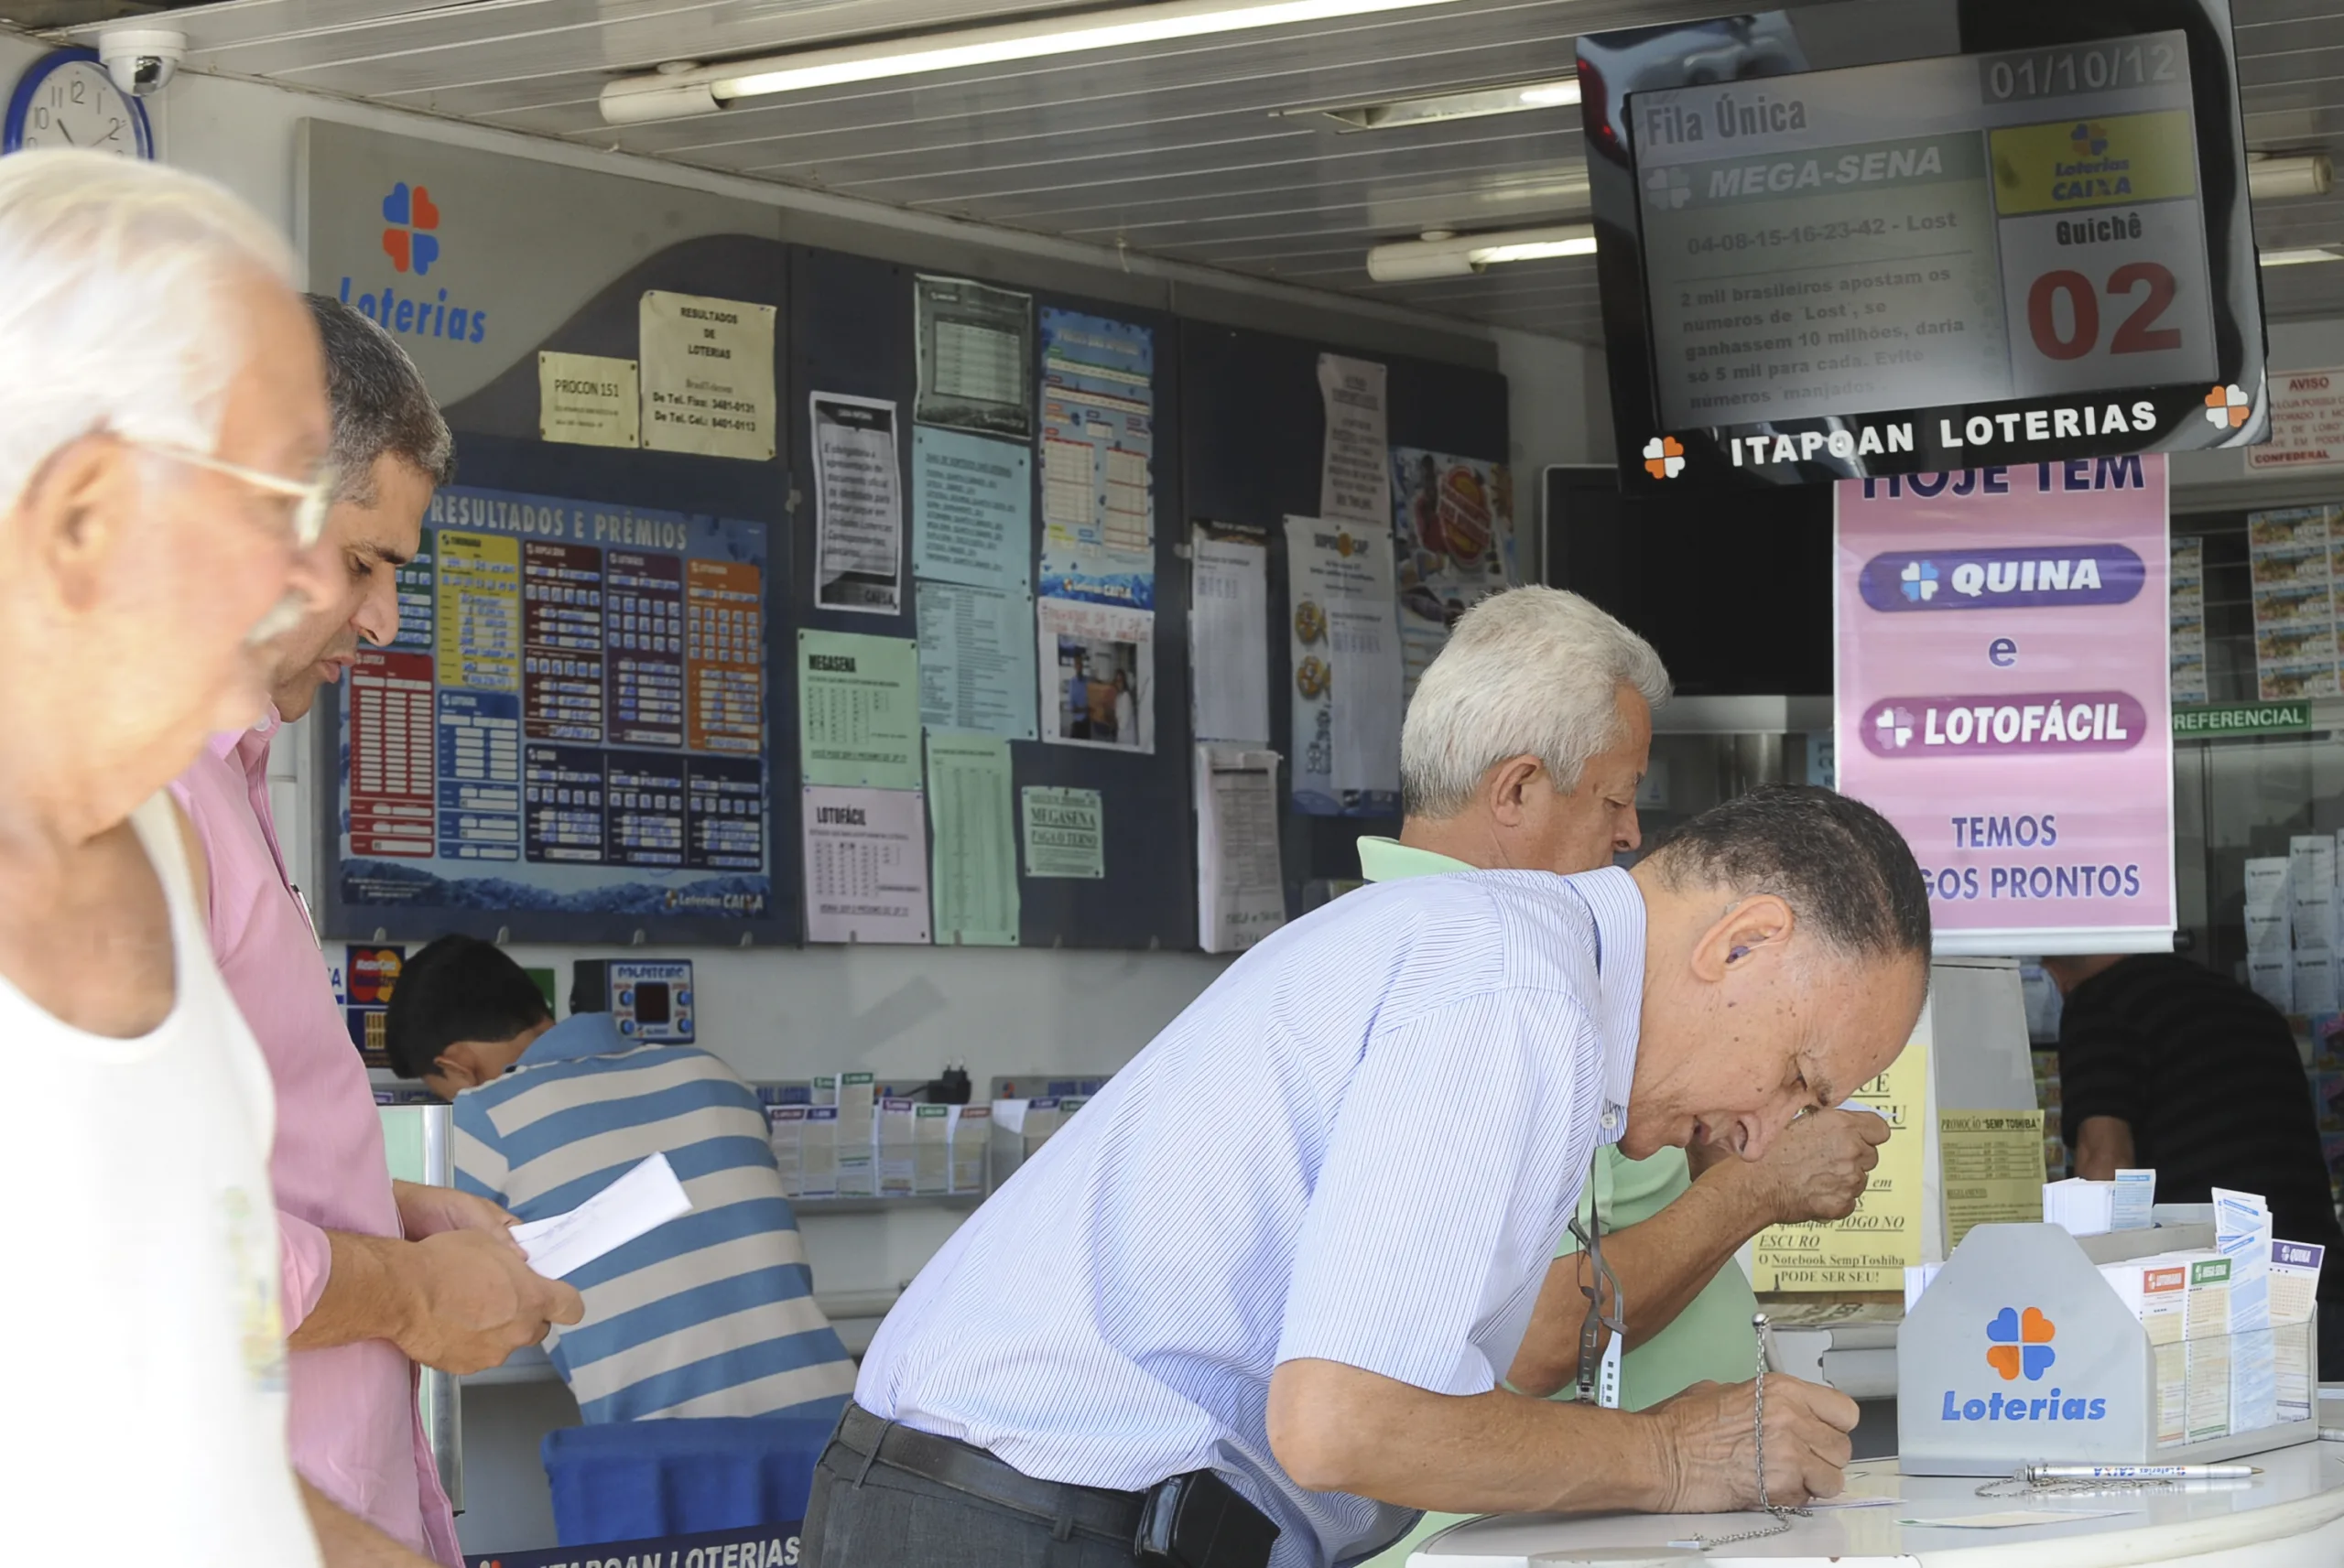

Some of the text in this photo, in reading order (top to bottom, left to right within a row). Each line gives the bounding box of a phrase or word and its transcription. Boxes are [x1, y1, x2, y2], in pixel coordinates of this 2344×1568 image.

[1990, 42, 2176, 98] 01/10/12
[71, 81, 85, 103] 12
[34, 107, 49, 129] 10
[109, 117, 120, 140] 2
[1647, 93, 1807, 146] Fila Única
[1708, 146, 1942, 199] MEGA-SENA
[2055, 158, 2130, 177] Loterias
[2051, 177, 2132, 201] CAIXA
[1906, 211, 1959, 232] Lost
[2056, 212, 2143, 245] Guichê
[1680, 268, 1952, 308] 2 mil brasileiros apostam os
[680, 307, 739, 324] RESULTADOS
[1770, 308, 1793, 324] de
[1864, 300, 1887, 315] se
[2028, 263, 2182, 361] 02
[703, 329, 717, 339] DE
[1685, 338, 1793, 362] ganhassem
[1797, 330, 1821, 348] 10
[1915, 319, 1966, 336] daria
[688, 344, 732, 359] LOTERIAS
[1716, 366, 1727, 381] 5
[1732, 362, 1762, 379] mil
[1768, 361, 1811, 380] para
[1874, 347, 1924, 366] Evite
[554, 378, 619, 397] PROCON 151
[2289, 376, 2330, 391] AVISO
[1731, 400, 2157, 467] ITAPOAN LOTERIAS
[2254, 449, 2330, 464] CONFEDERAL
[431, 494, 687, 550] RESULTADOS E PRÊMIOS
[1951, 559, 2102, 598] QUINA
[1988, 637, 2018, 667] e
[808, 654, 856, 673] MEGASENA
[1924, 699, 2127, 745] LOTOFÁCIL
[816, 806, 866, 826] LOTOFÁCIL
[1031, 807, 1096, 827] MEGASENA
[1952, 815, 2057, 849] TEMOS
[1991, 864, 2140, 899] PRONTOS
[1941, 1116, 1981, 1131] PROMOÇÃO
[1872, 1179, 1892, 1188] em
[1838, 1215, 1879, 1228] JOGO
[1882, 1215, 1905, 1228] NO
[1759, 1234, 1820, 1249] ESCURO
[1758, 1254, 1769, 1265] O
[1772, 1253, 1827, 1266] Notebook
[1781, 1271, 1880, 1282] PODE SER SEU!
[1941, 1388, 2107, 1422] Loterias
[2094, 1466, 2176, 1476] Loterias CAIXA
